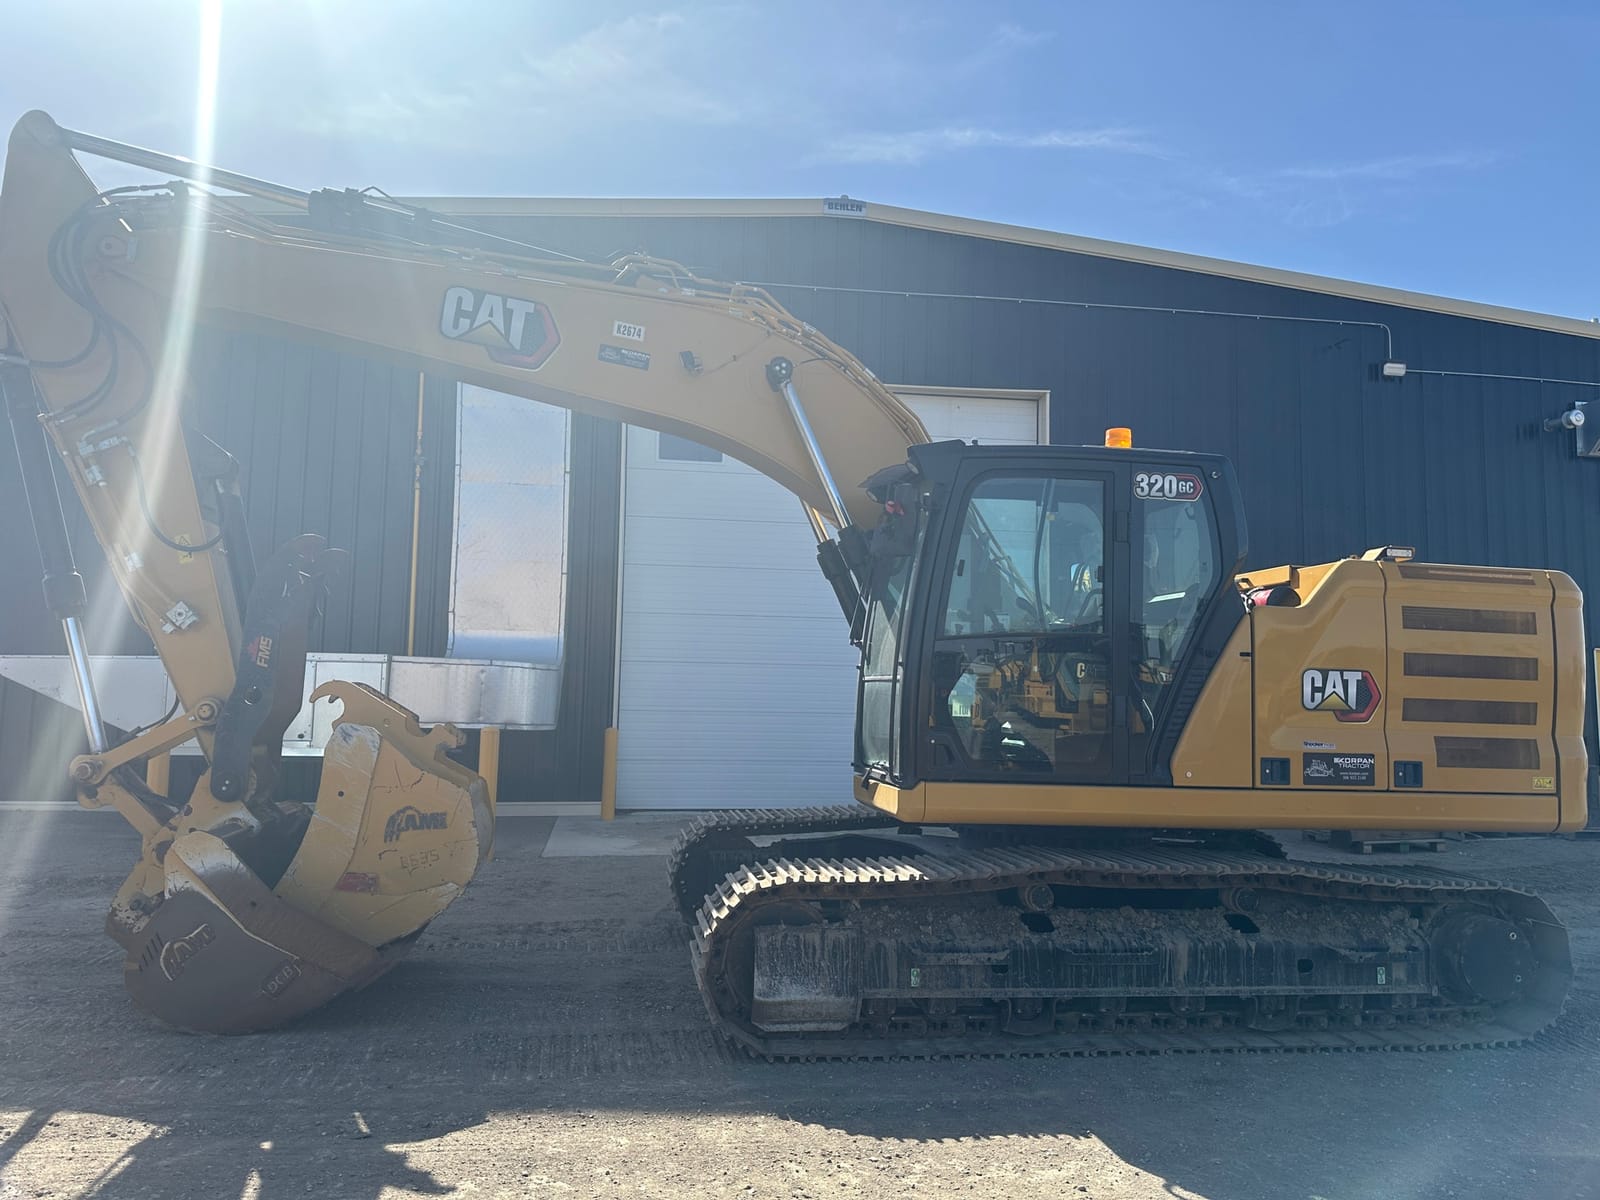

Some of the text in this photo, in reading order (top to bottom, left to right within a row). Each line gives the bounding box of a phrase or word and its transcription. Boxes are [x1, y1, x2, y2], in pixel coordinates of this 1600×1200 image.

[441, 287, 536, 350] CAT
[616, 323, 642, 339] K2674
[1135, 473, 1194, 498] 320 GC
[256, 636, 272, 668] FMS
[1303, 669, 1362, 710] CAT
